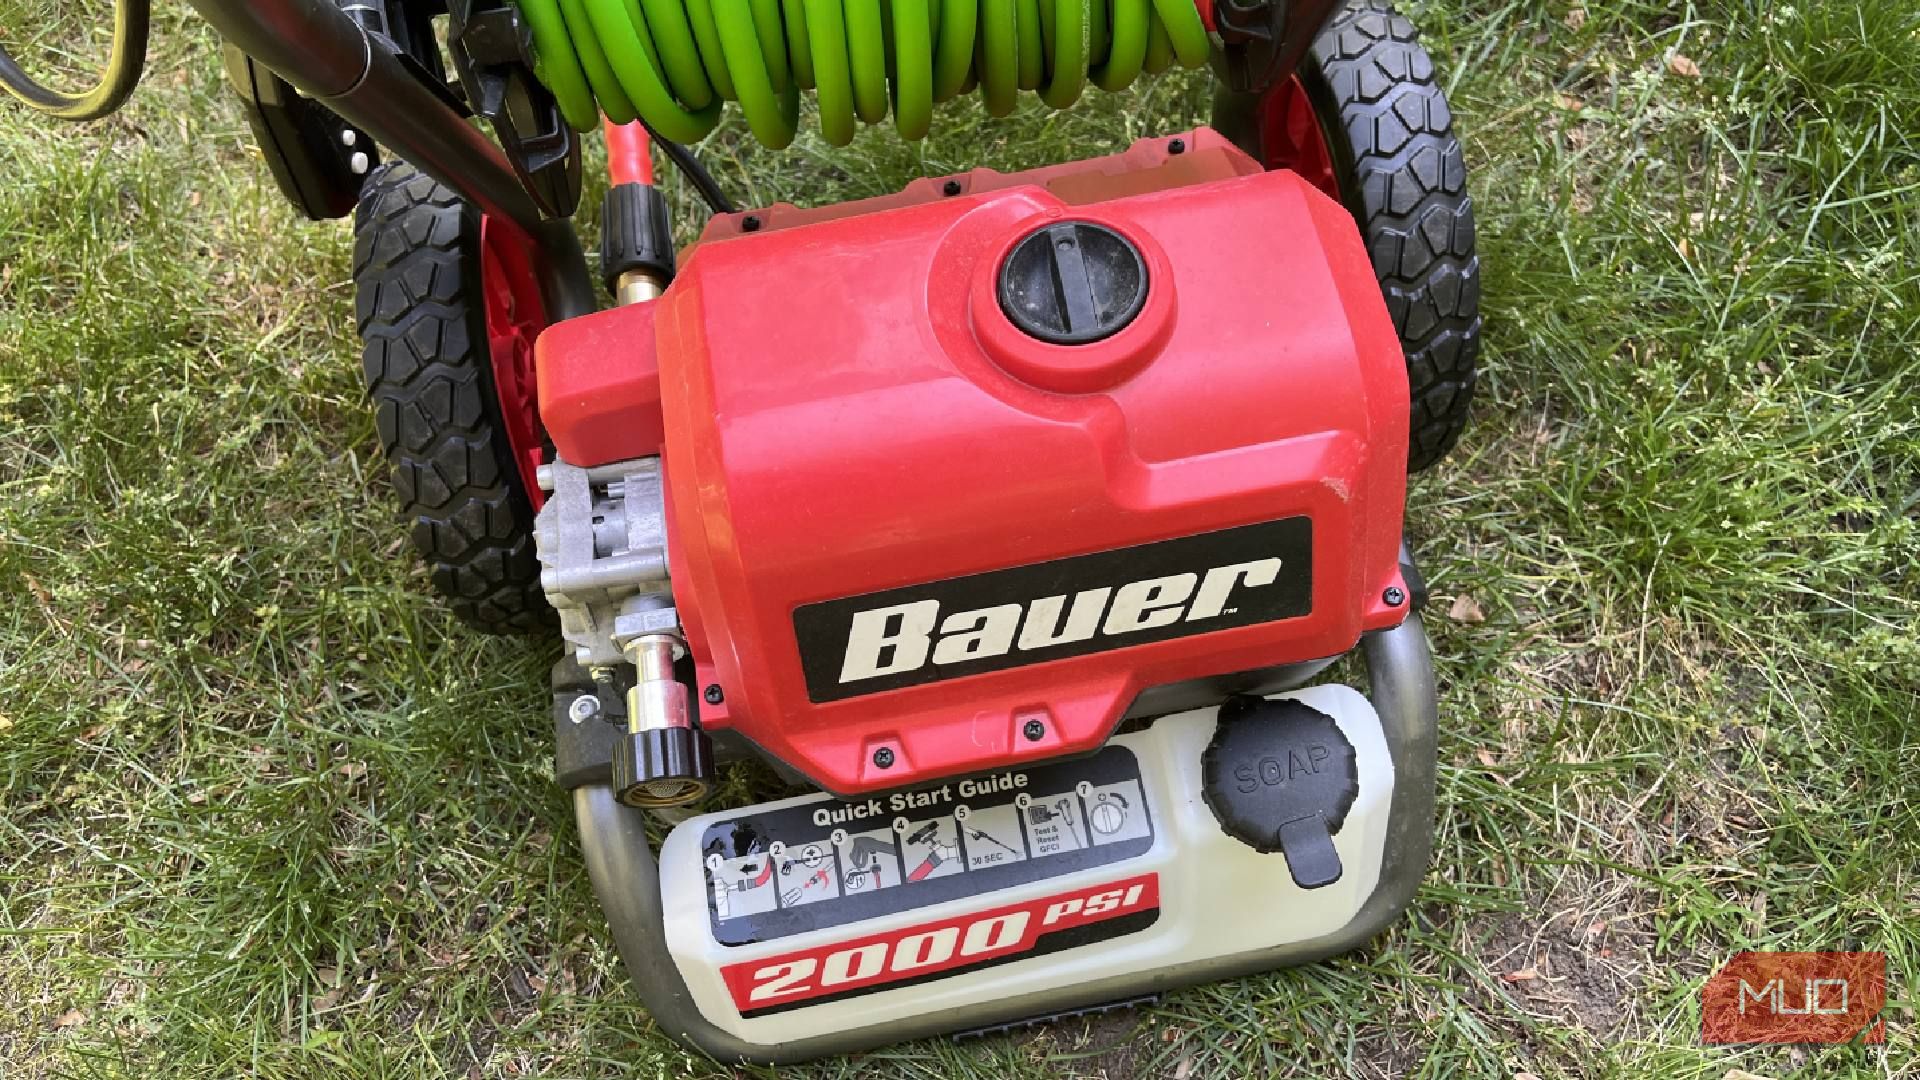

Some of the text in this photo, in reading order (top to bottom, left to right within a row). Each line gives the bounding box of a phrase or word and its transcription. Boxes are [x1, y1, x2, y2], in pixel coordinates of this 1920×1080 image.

[838, 557, 1282, 683] Bauer
[1234, 745, 1329, 794] SOAP
[813, 773, 1029, 826] Quick Start Guide
[1034, 826, 1051, 837] Test
[972, 852, 1003, 866] 30 SEC
[749, 884, 1144, 1001] 2000 PSI
